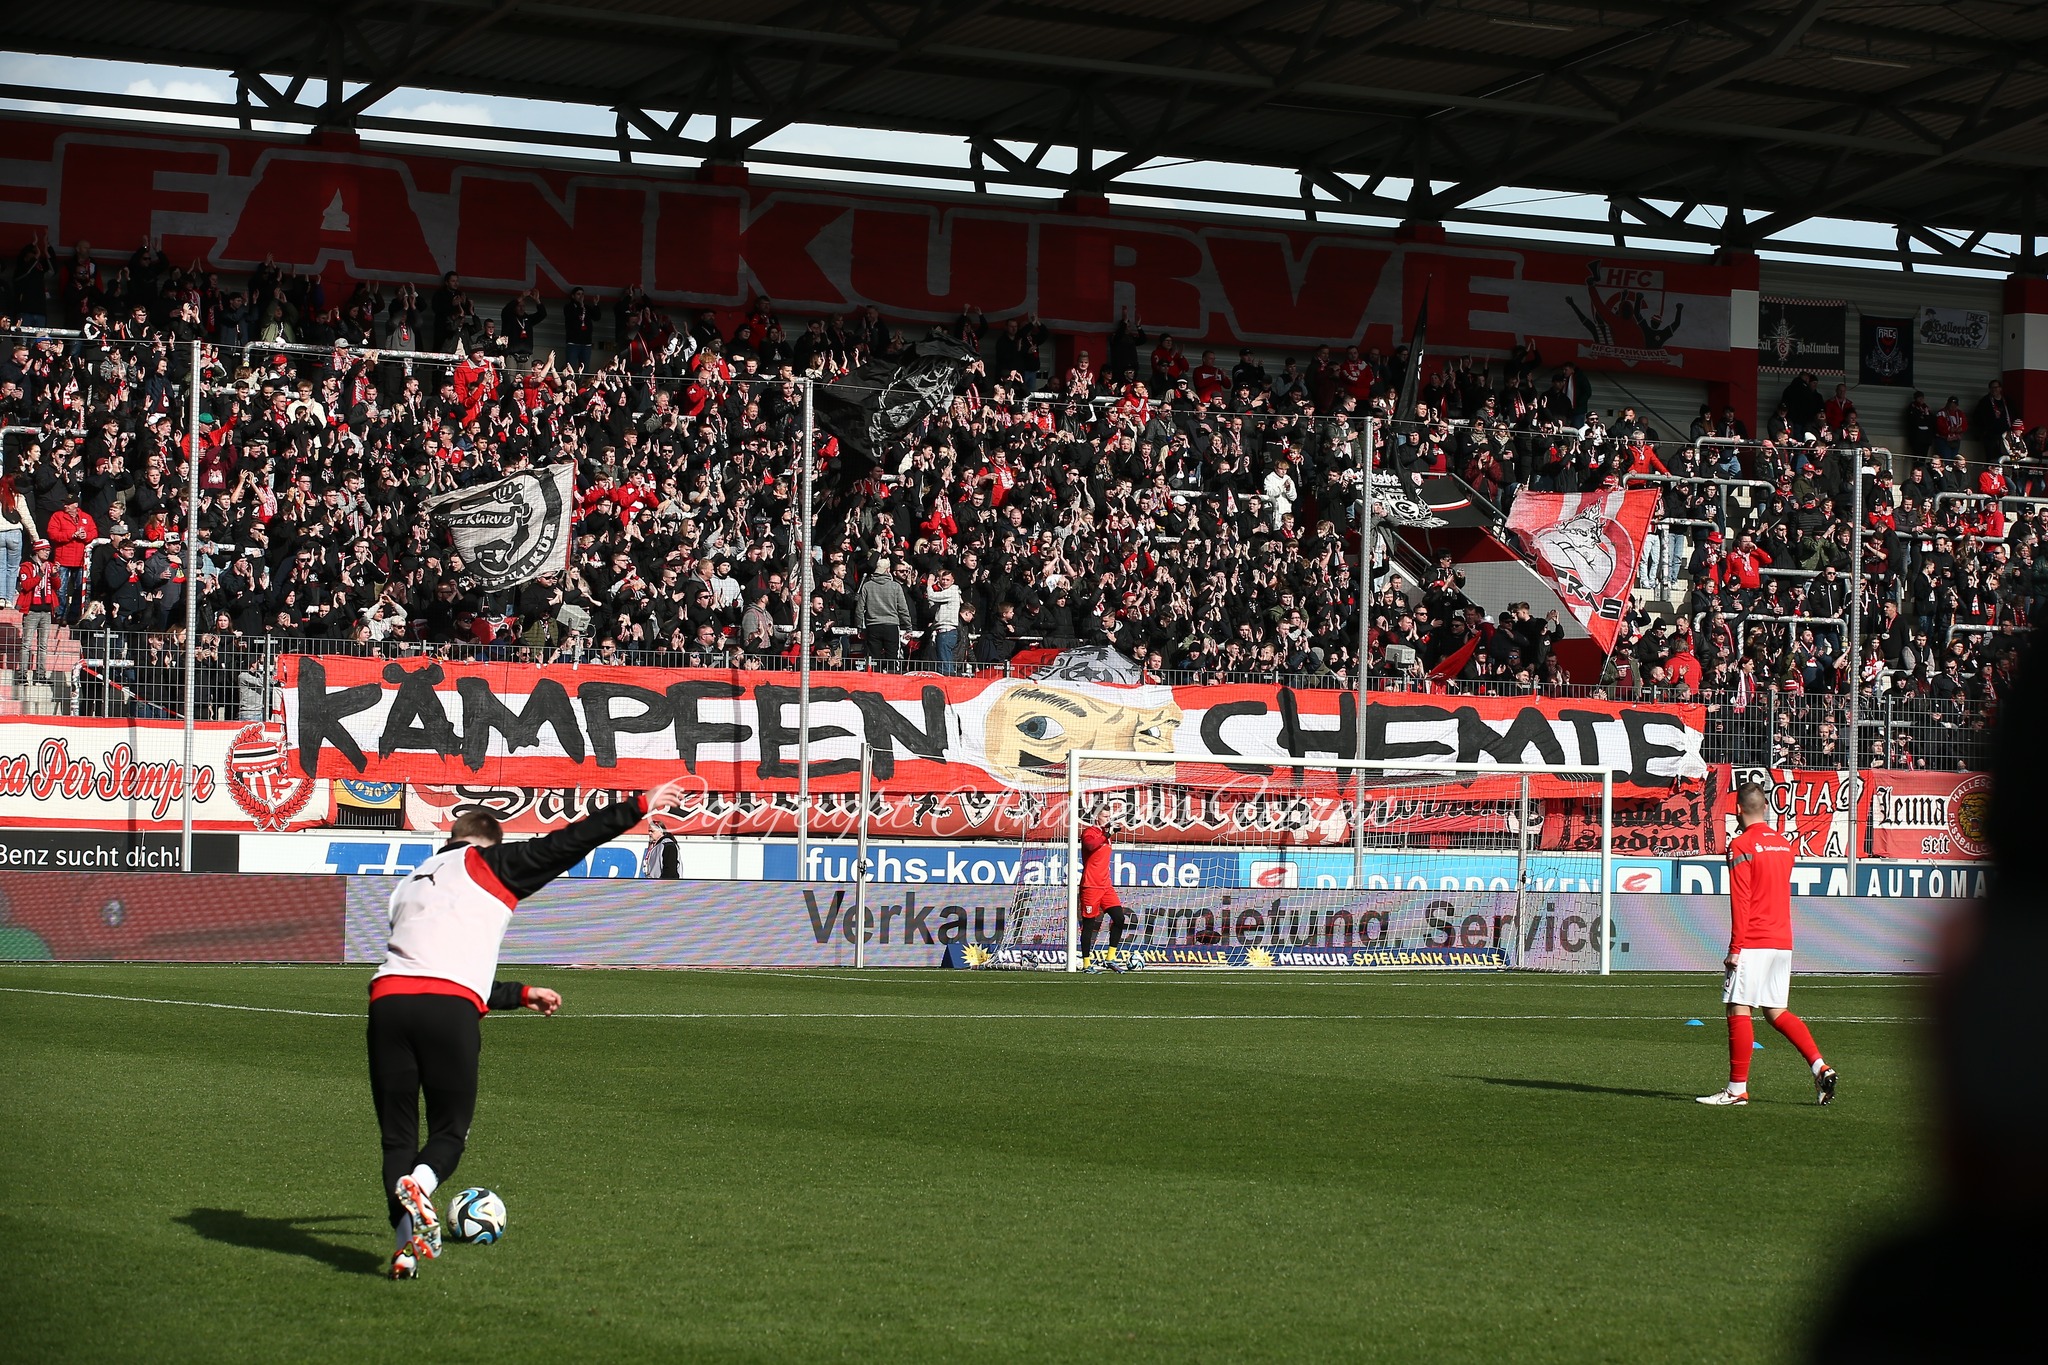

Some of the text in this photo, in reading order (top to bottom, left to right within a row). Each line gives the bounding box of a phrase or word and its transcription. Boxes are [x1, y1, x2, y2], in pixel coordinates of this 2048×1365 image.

[54, 132, 1527, 356] FANKURVE
[1607, 269, 1653, 287] HFC
[298, 657, 947, 781] KÄMPFEN
[31, 738, 96, 800] Per
[1876, 786, 1947, 828] Leuna
[55, 845, 119, 867] sucht
[126, 845, 181, 868] dich!
[1921, 834, 1950, 854] seit
[807, 847, 1200, 886] fuchs-kovatsh.de
[1681, 865, 1990, 898] DTA AUTOMA
[1425, 900, 1631, 953] Service.
[1174, 949, 1227, 963] HALLE
[1278, 951, 1502, 966] MERKUR SPIELBANK HALLE
